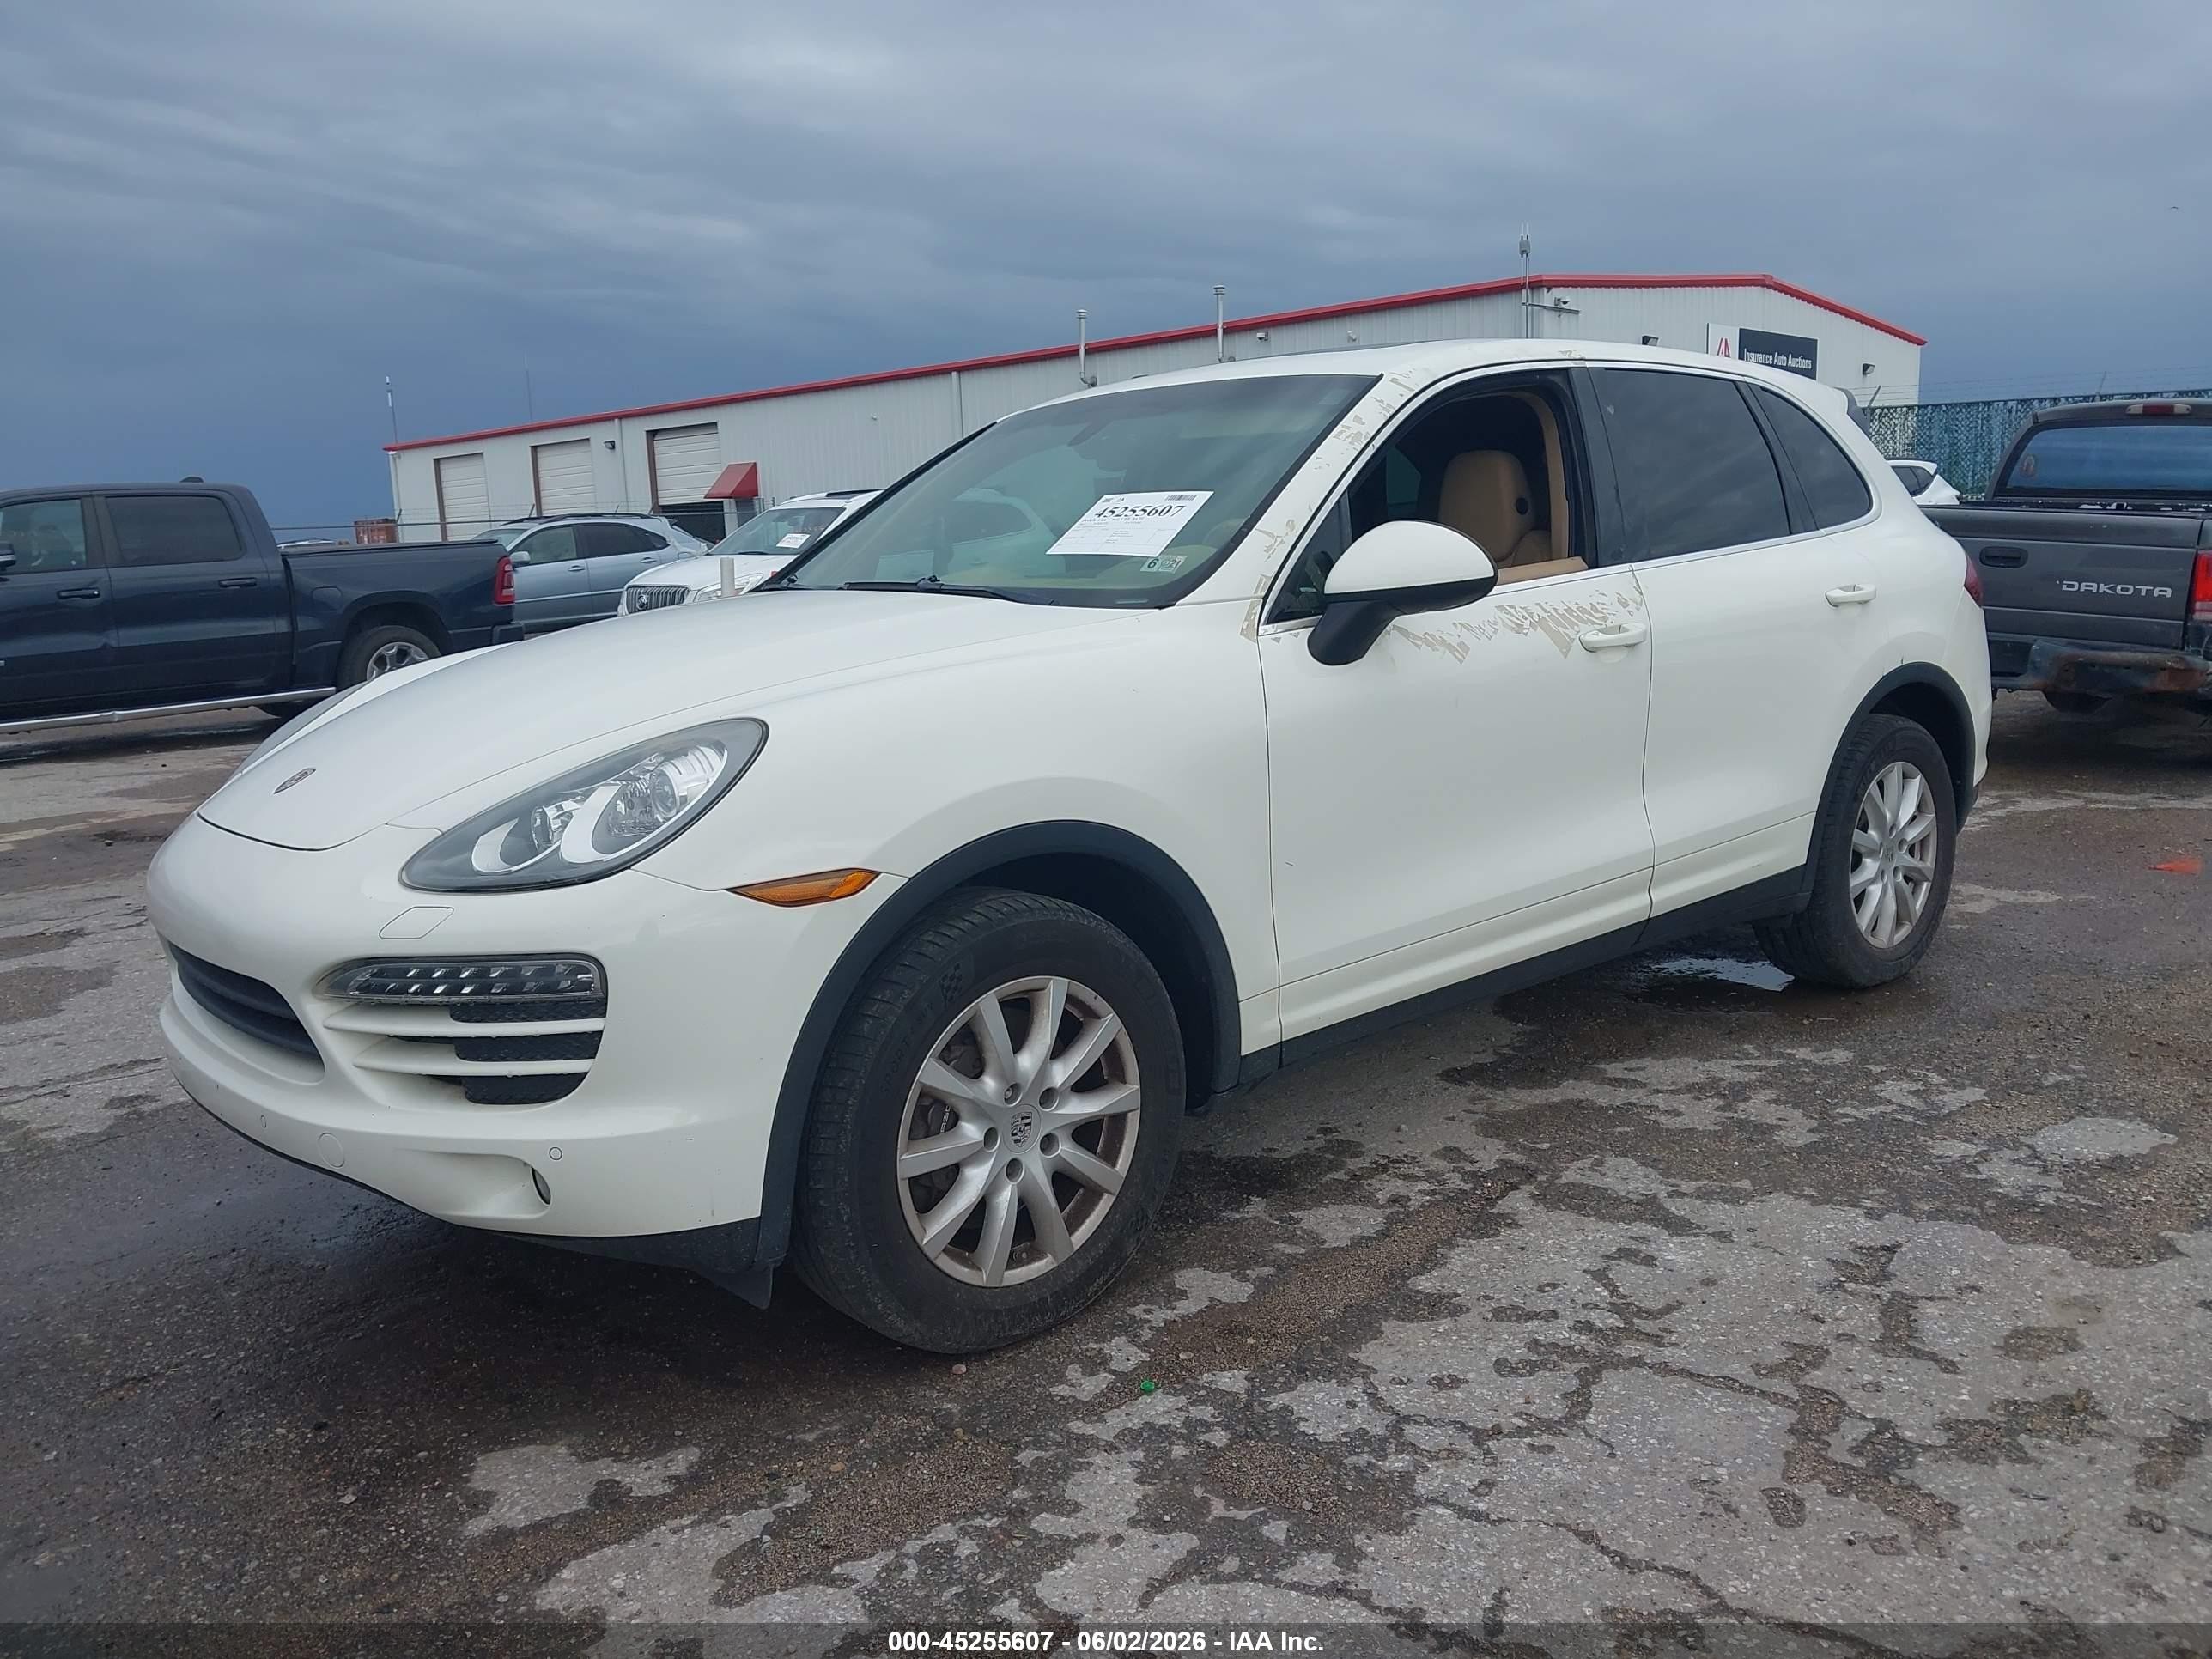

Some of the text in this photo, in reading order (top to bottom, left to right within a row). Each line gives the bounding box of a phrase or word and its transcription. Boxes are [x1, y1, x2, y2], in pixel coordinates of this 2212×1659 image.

[1744, 348, 1772, 364] Insurance
[1774, 352, 1787, 367] Auto
[1788, 353, 1812, 369] Auctions
[1095, 505, 1186, 518] 45255607
[1146, 558, 1159, 568] 6
[2062, 580, 2172, 598] DAKOTA
